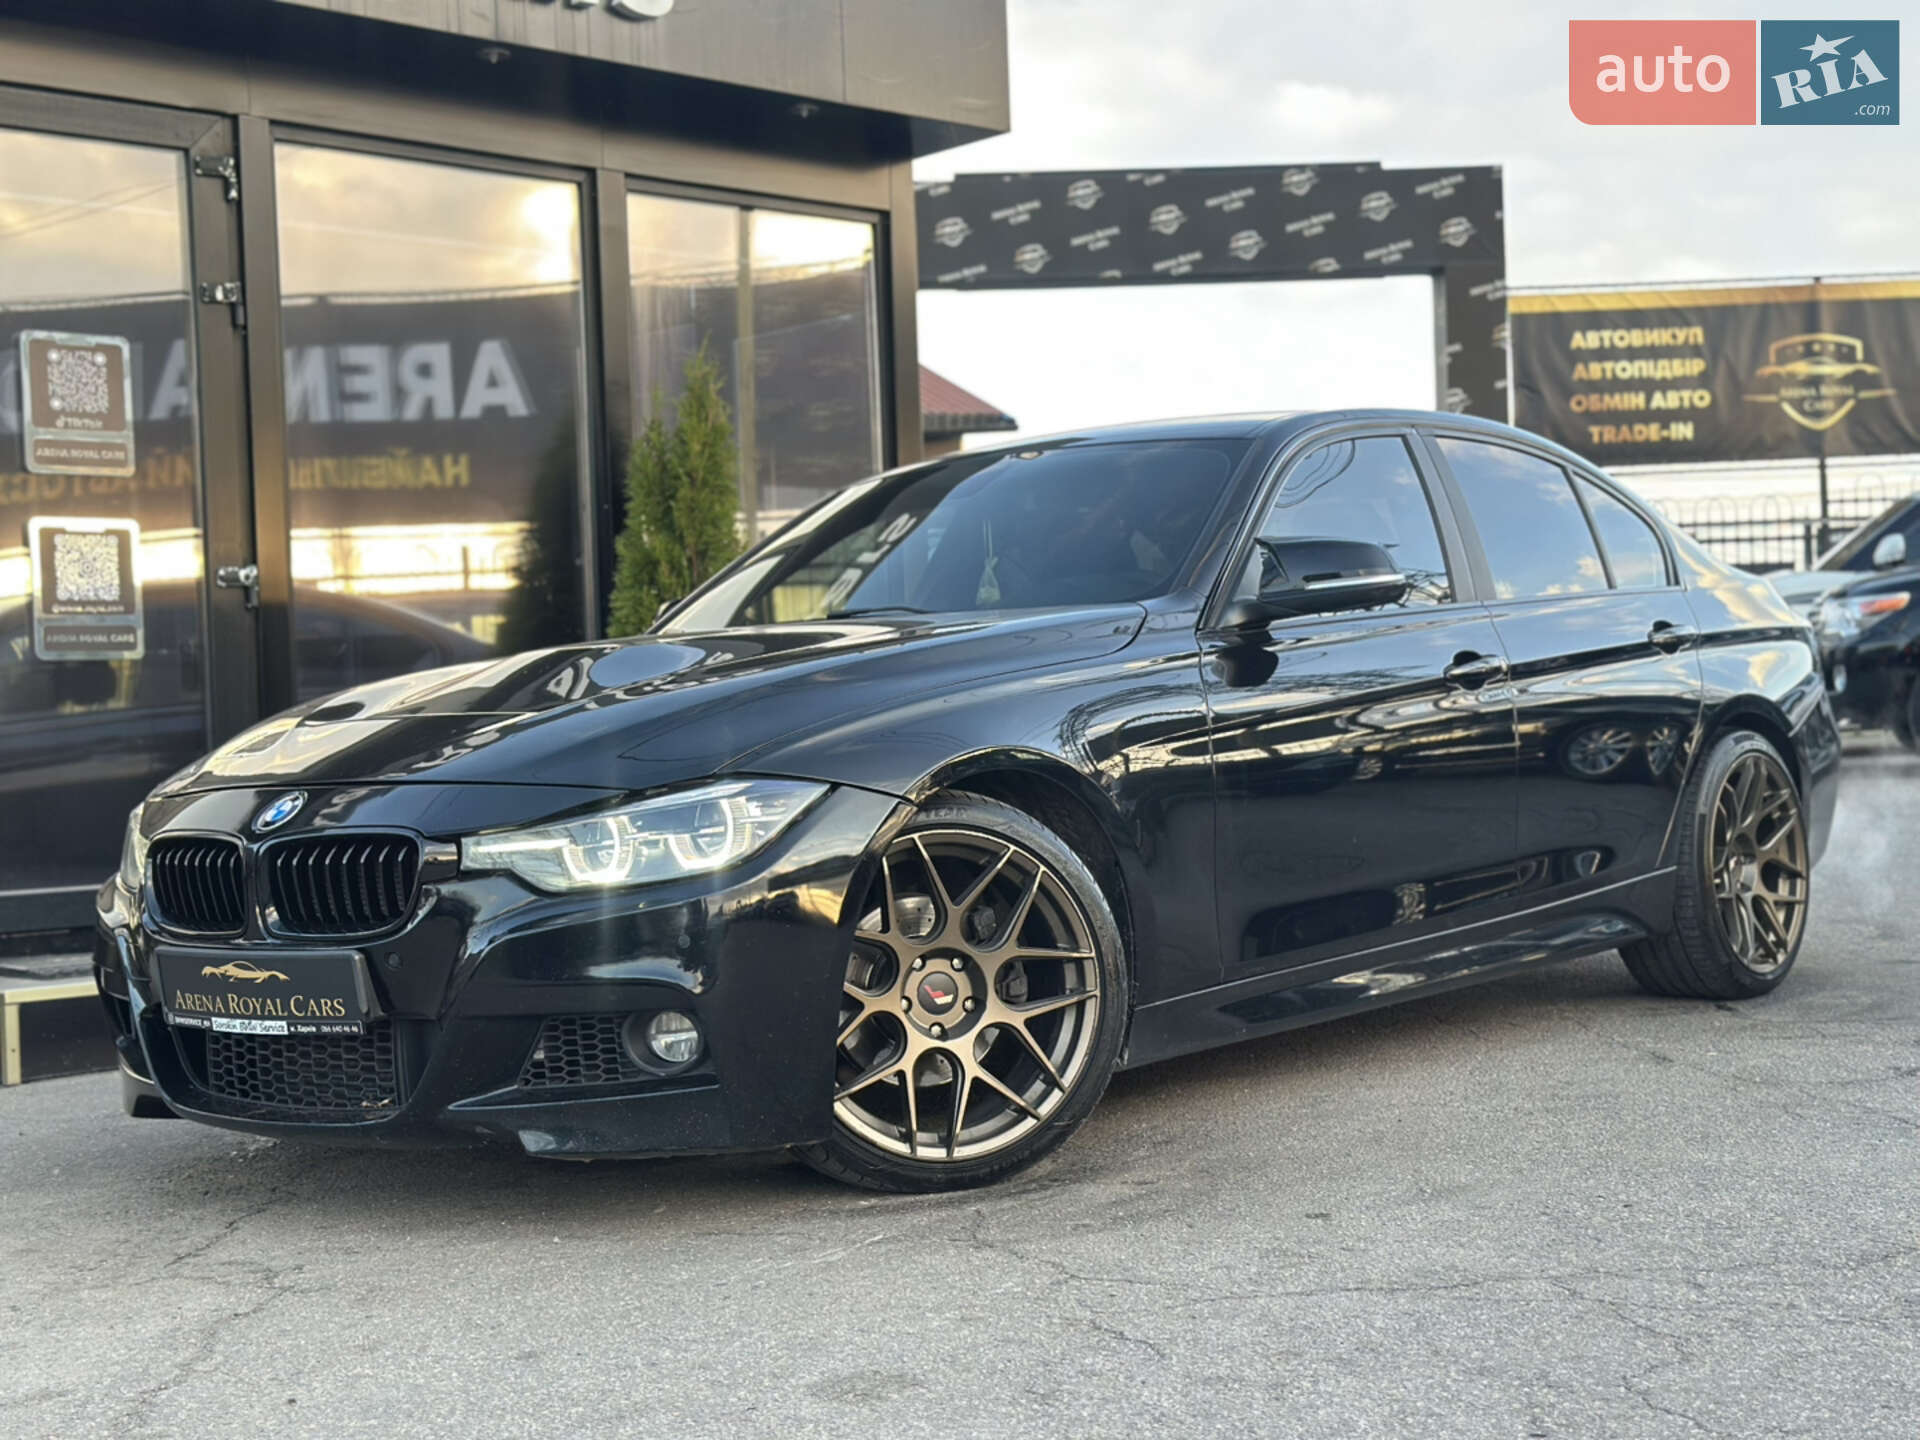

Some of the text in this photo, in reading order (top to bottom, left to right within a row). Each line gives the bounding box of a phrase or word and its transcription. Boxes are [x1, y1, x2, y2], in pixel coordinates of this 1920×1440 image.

[1570, 326, 1705, 350] АВТОВИКУП
[1572, 357, 1706, 381] АВТОПІДБІР
[1569, 388, 1711, 414] ОБМІН АВТО
[1588, 421, 1694, 444] TRADE-IN
[175, 989, 346, 1017] ARENA ROYAL CARS
